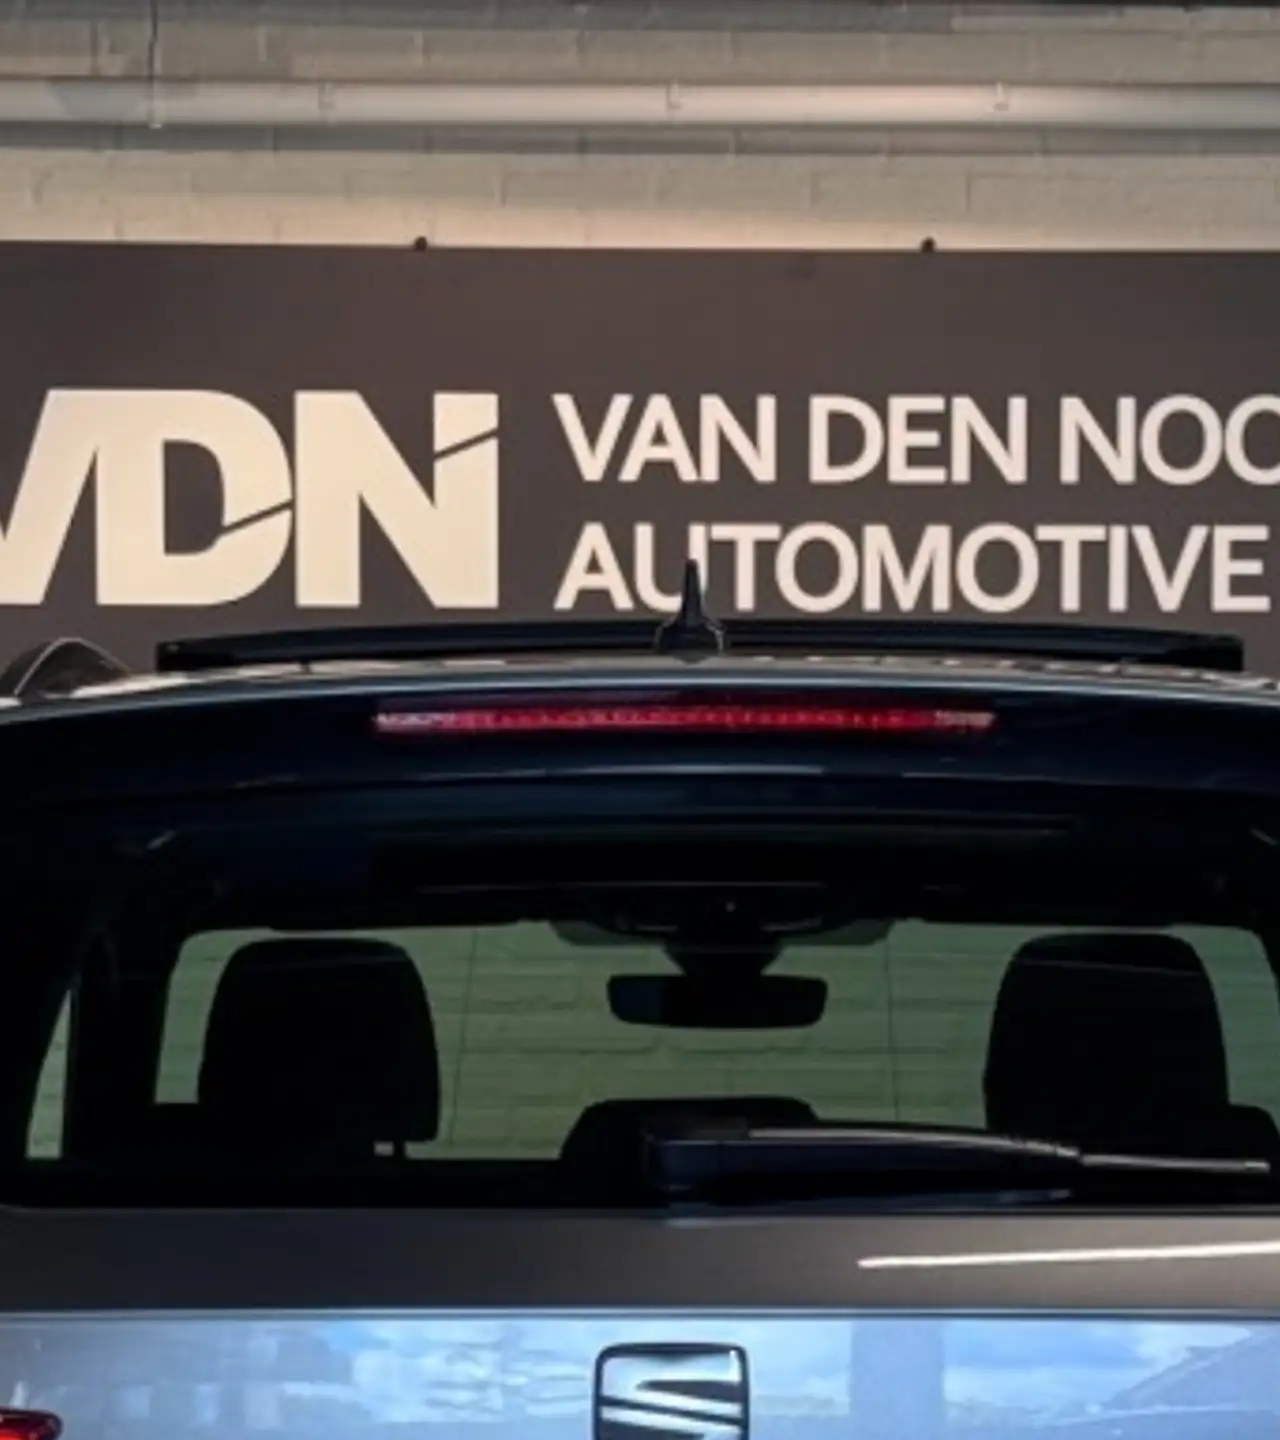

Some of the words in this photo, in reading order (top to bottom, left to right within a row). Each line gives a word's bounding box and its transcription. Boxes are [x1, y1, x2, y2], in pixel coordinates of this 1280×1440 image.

[552, 393, 777, 484] VAN
[808, 395, 1027, 485] DEN
[554, 522, 1271, 615] AUTOMOTIVE
